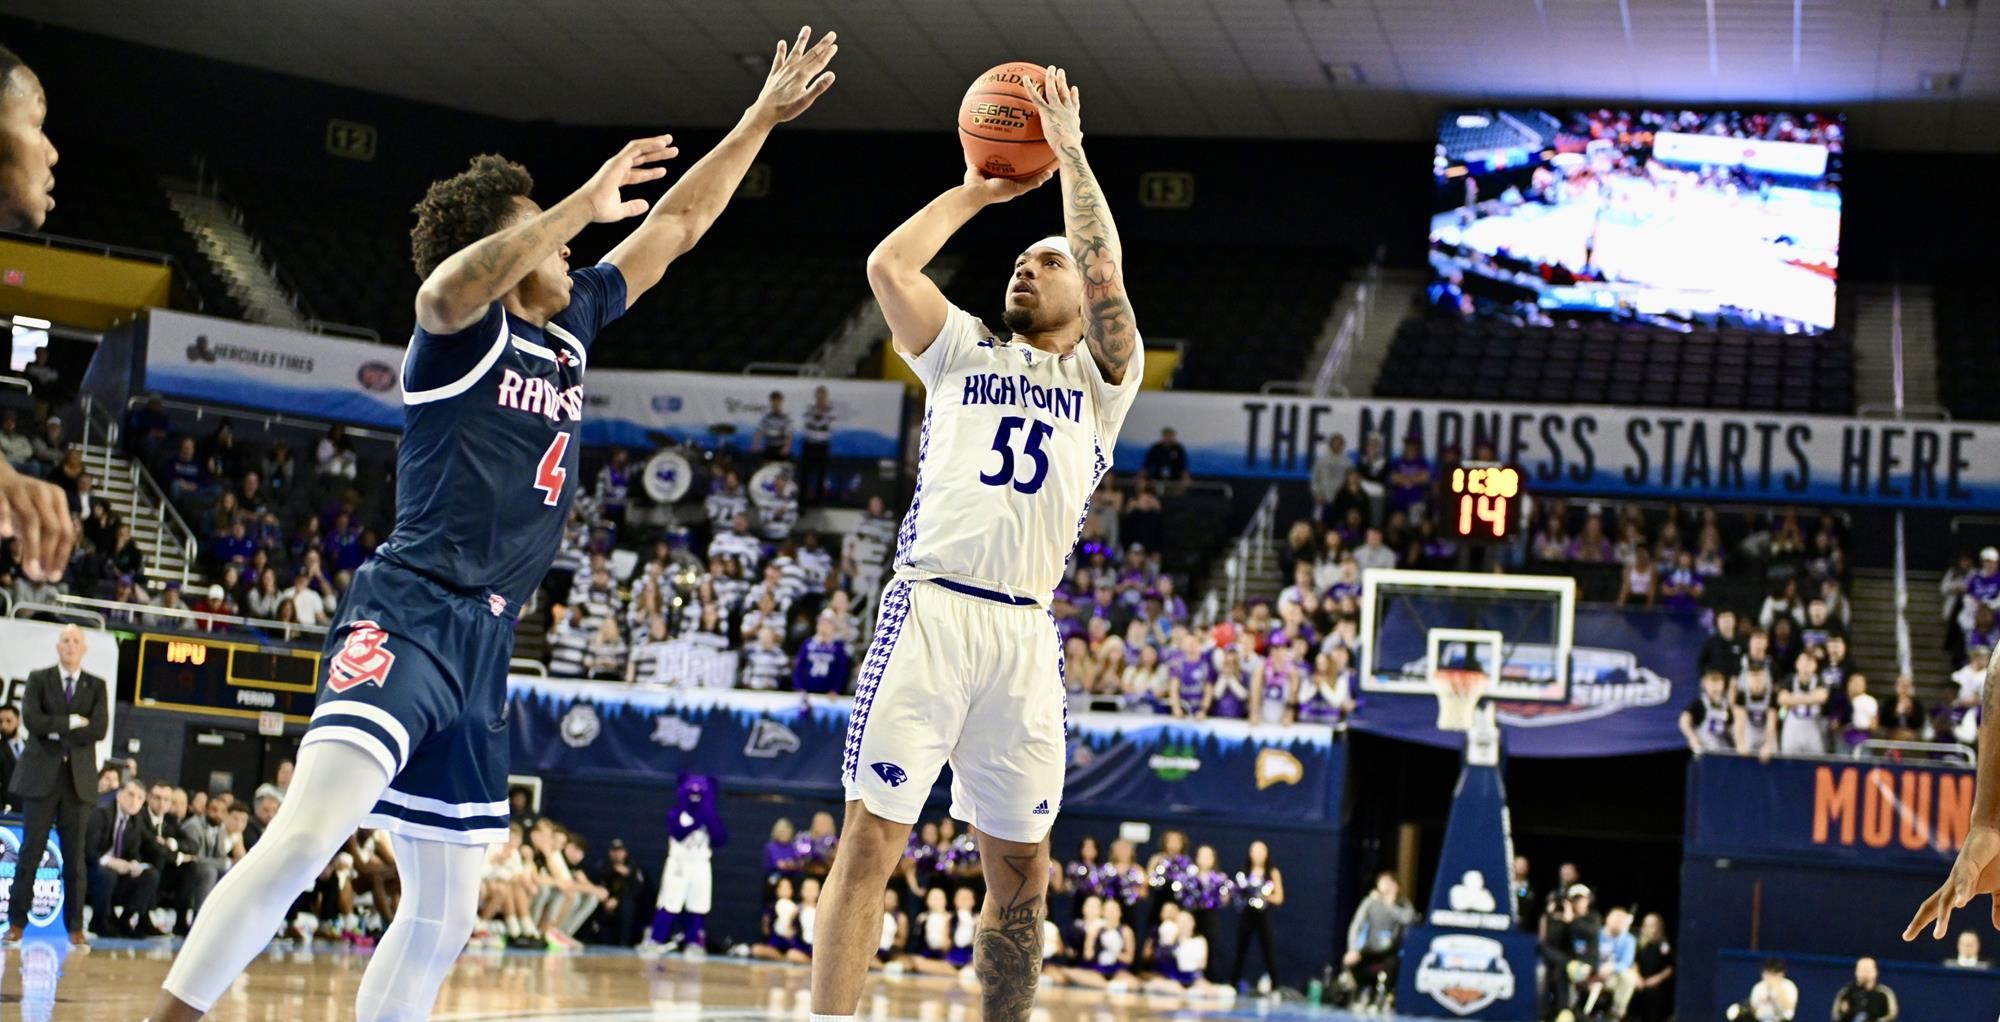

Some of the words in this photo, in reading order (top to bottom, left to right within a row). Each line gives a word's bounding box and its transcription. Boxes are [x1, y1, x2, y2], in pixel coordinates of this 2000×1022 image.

[970, 104, 1034, 121] LEGACY
[984, 118, 1025, 129] 1000
[336, 129, 368, 153] 12
[1151, 178, 1183, 202] 13
[214, 343, 276, 367] HERCULES
[279, 352, 315, 374] TIRES
[962, 373, 1016, 406] HIGH
[1019, 374, 1084, 423] POINT
[533, 431, 571, 507] 4
[980, 416, 1054, 494] 55
[1244, 403, 1331, 471] THE
[1358, 407, 1597, 483] MADNESS
[1624, 417, 1812, 492] STARTS
[1840, 427, 1975, 499] HERE
[1459, 494, 1506, 537] 14
[236, 689, 276, 708] PERIOD
[1813, 766, 1974, 853] MOUN
